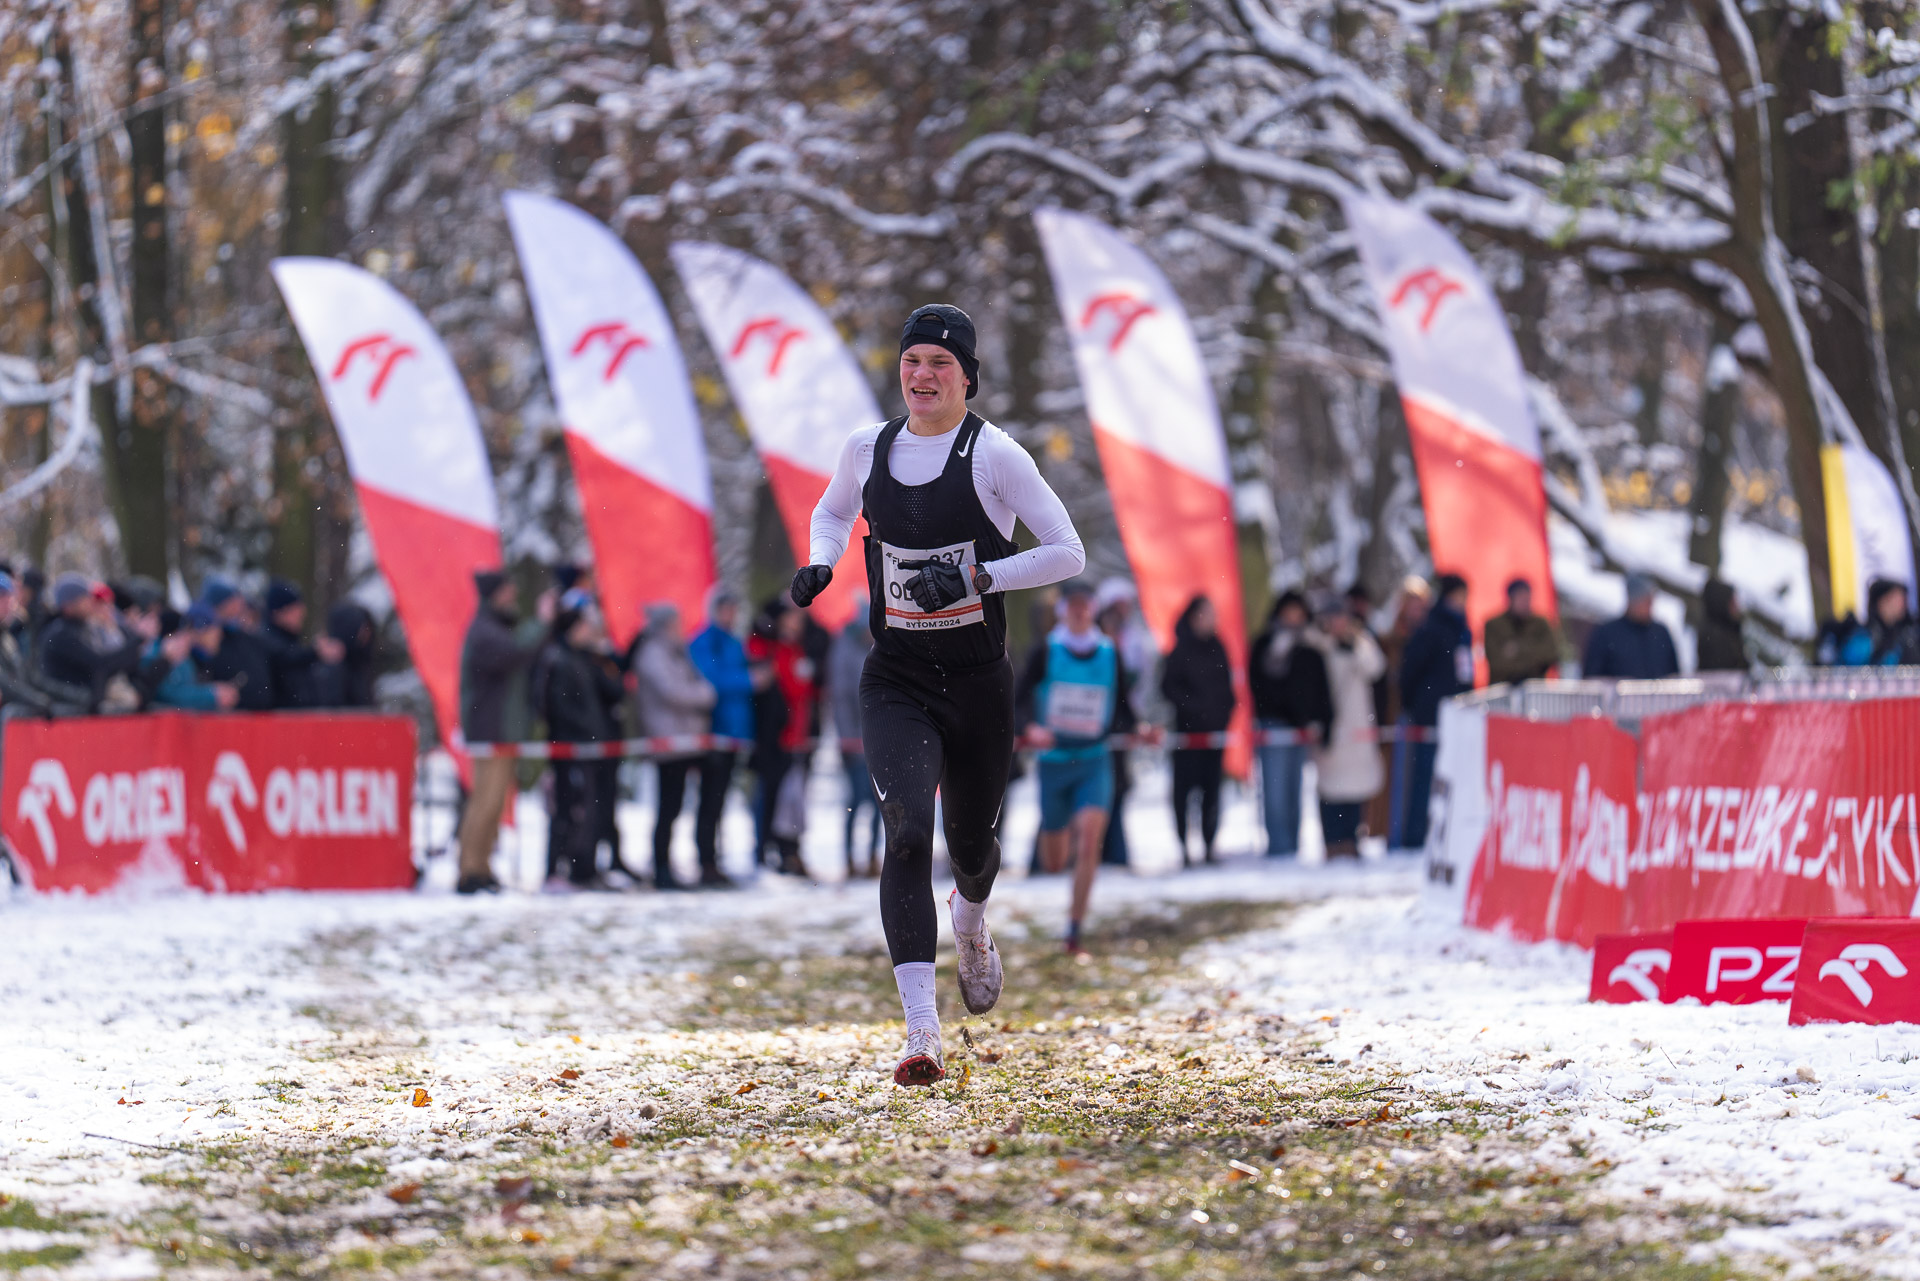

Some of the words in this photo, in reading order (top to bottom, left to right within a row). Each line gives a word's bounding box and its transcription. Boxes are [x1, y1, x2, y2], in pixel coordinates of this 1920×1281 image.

[922, 566, 943, 608] BRUBECK
[906, 620, 937, 629] BYTOM
[939, 618, 961, 628] 2024
[264, 767, 398, 838] ORLEN
